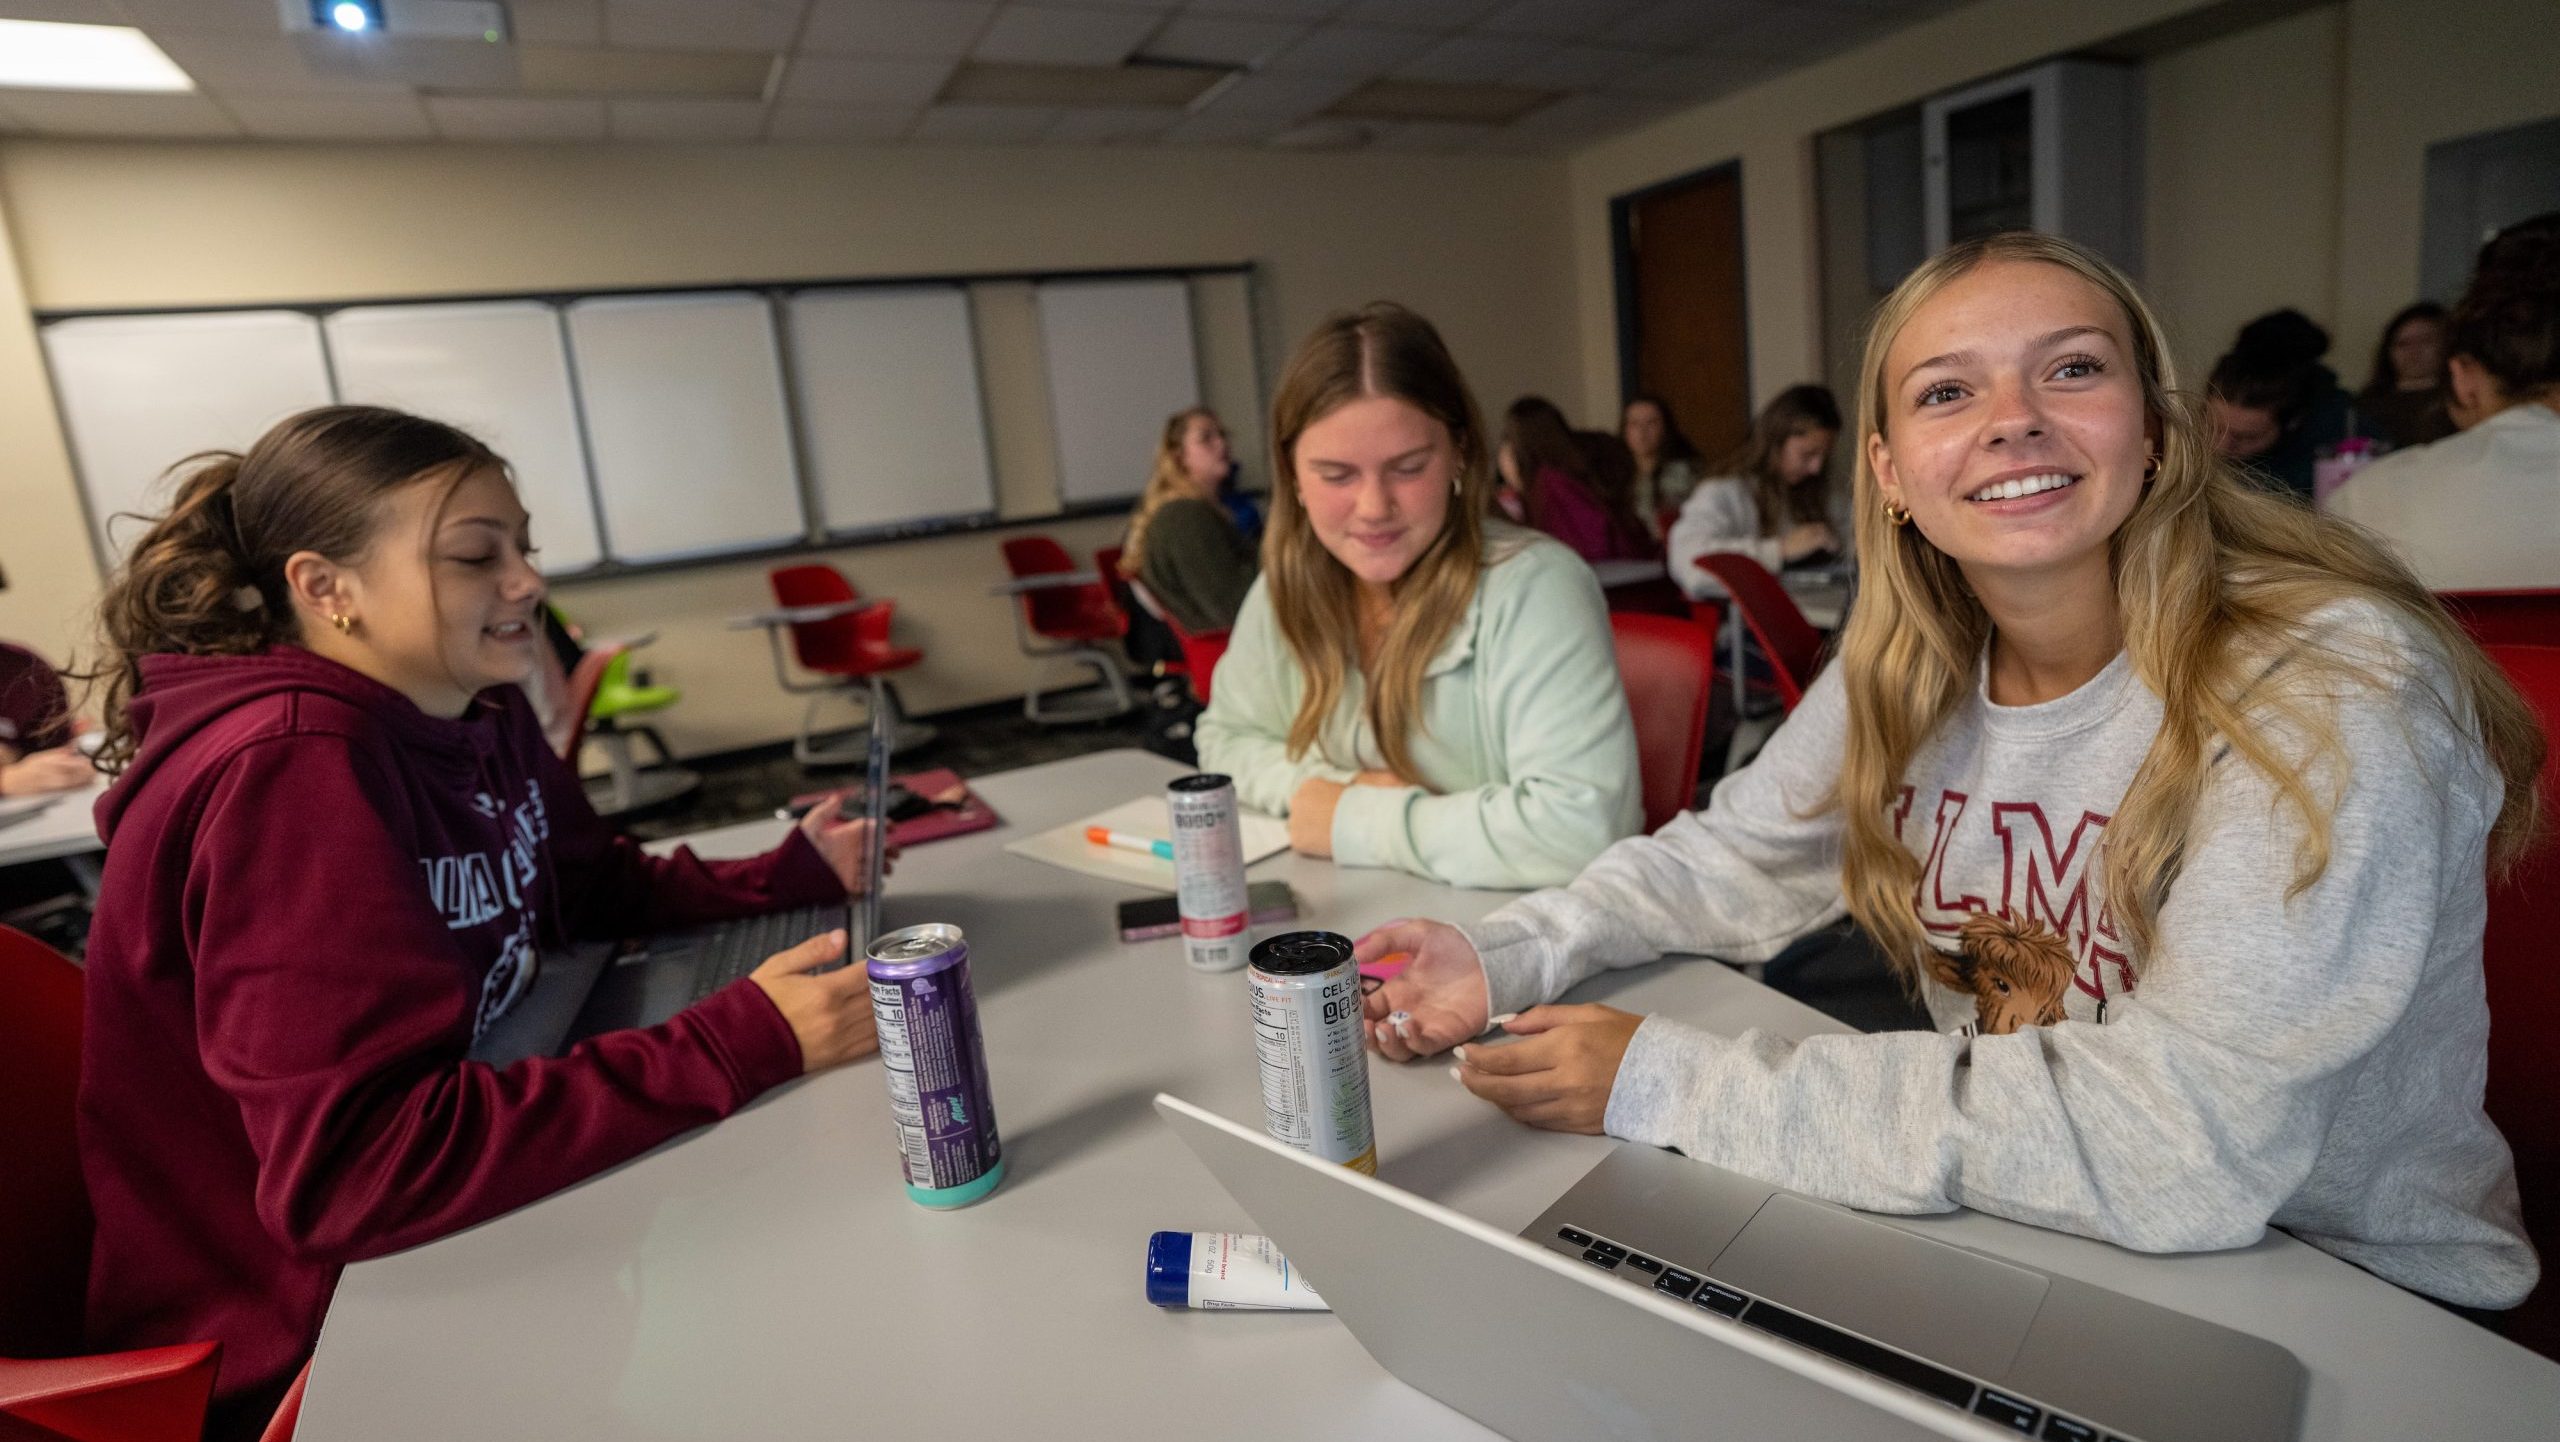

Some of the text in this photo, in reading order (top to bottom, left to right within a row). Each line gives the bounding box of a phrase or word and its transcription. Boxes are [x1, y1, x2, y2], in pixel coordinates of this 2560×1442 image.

[881, 986, 900, 996] Facts
[892, 1009, 904, 1020] 10
[1275, 1032, 1286, 1041] 10
[1669, 1271, 1692, 1282] option
[1706, 1285, 1742, 1302] command
